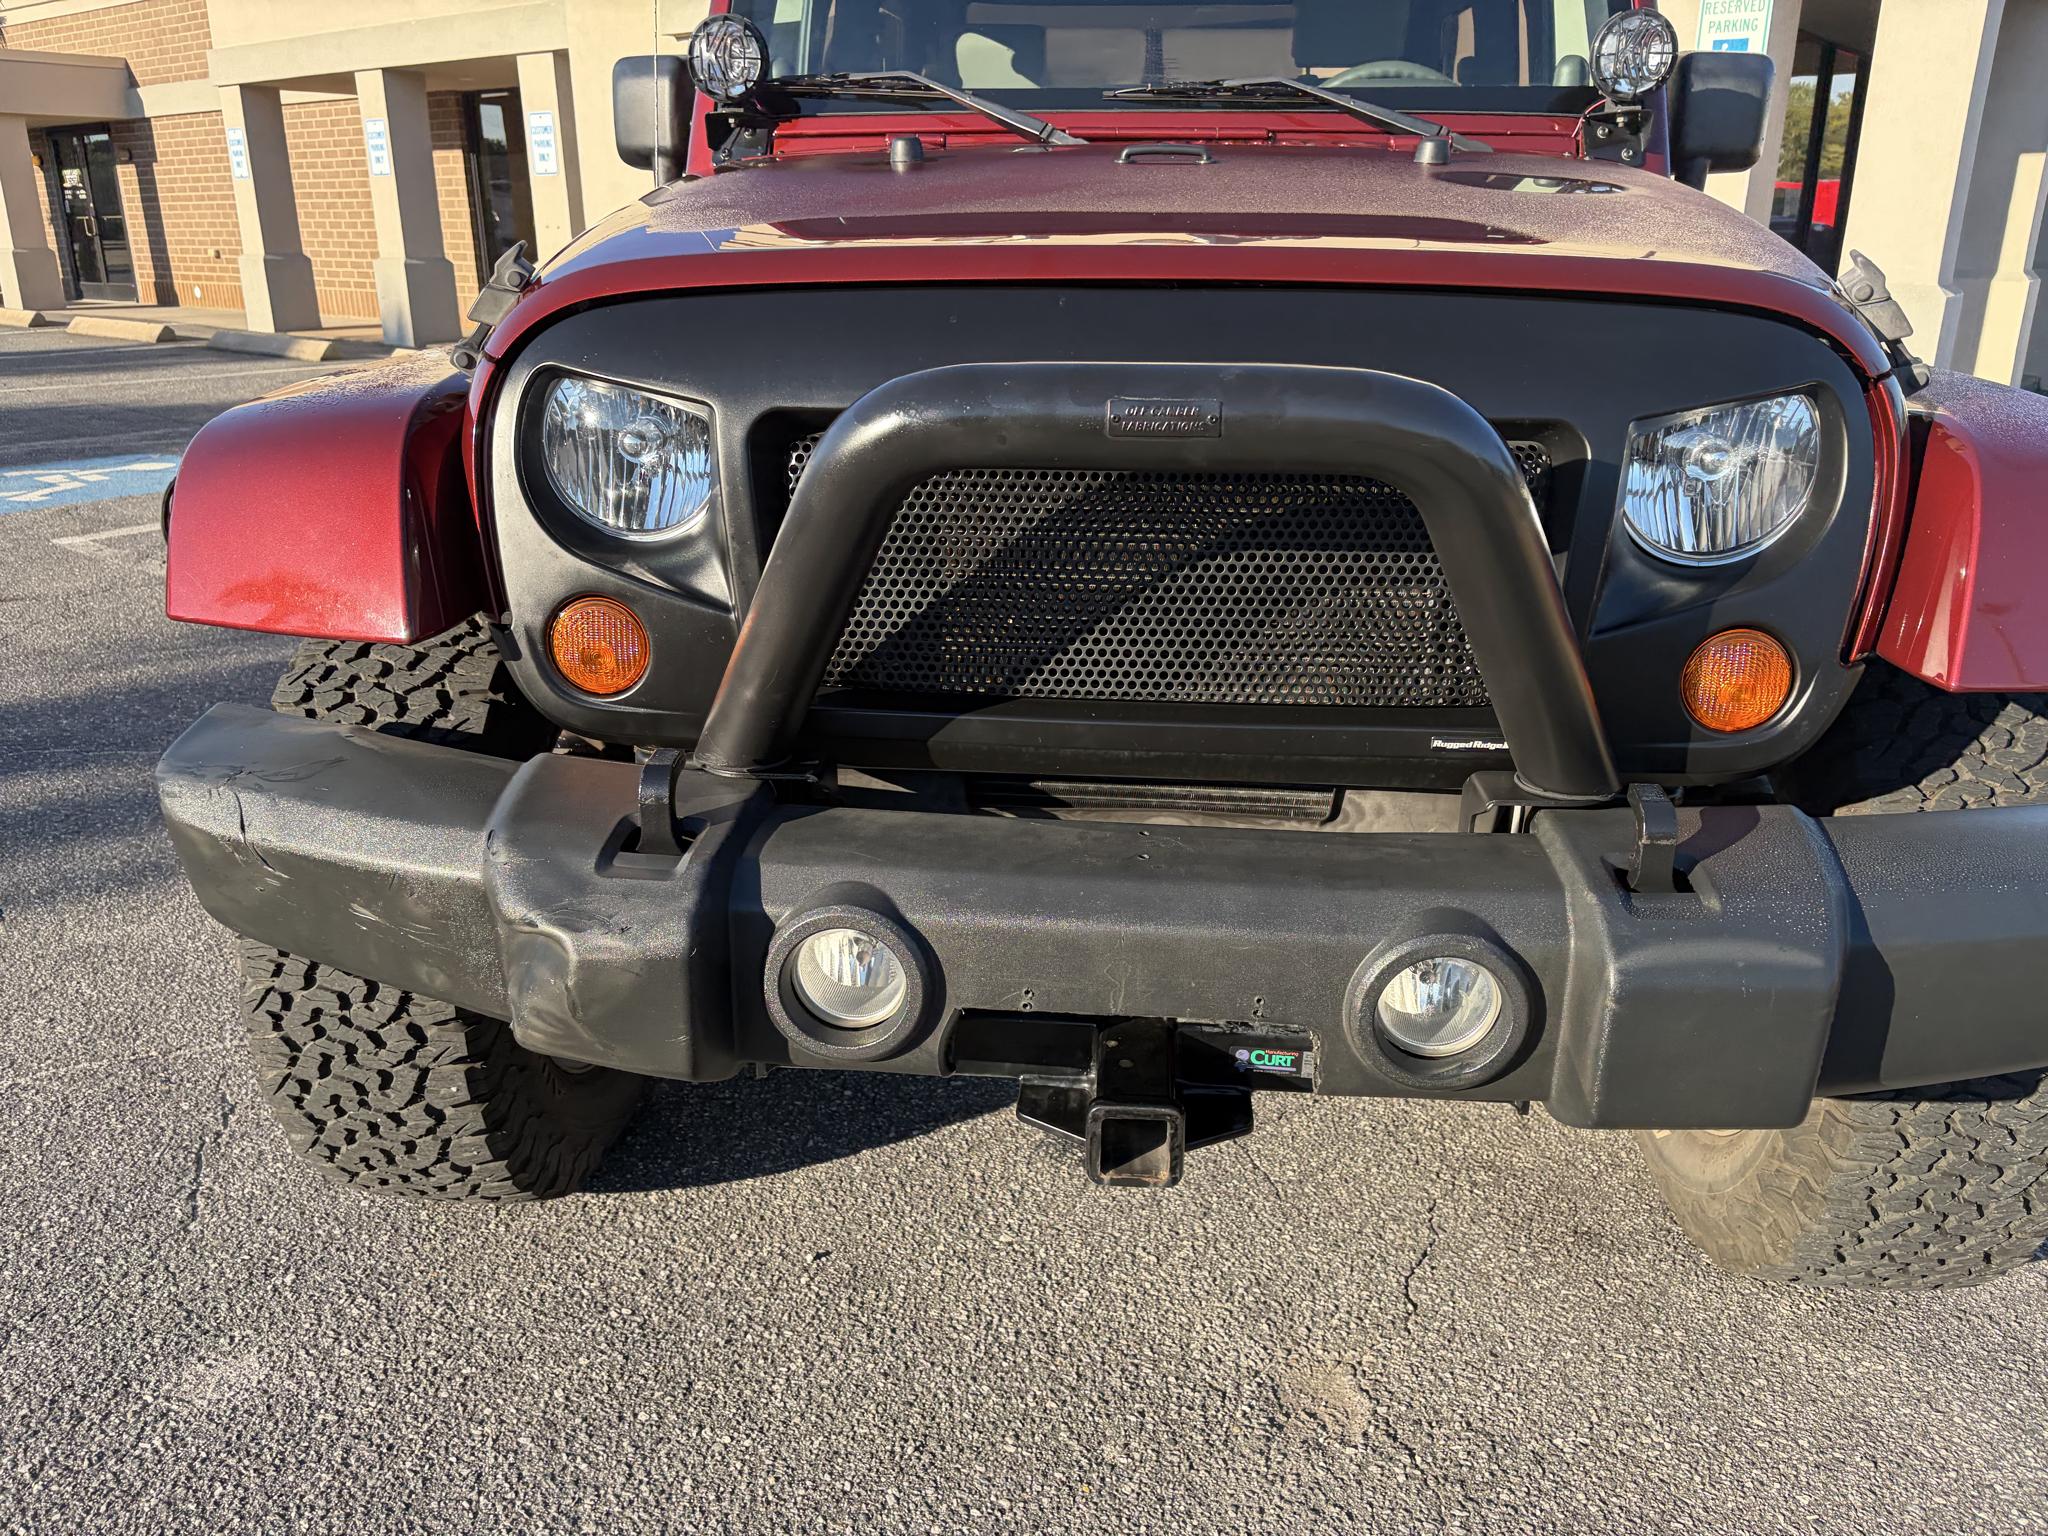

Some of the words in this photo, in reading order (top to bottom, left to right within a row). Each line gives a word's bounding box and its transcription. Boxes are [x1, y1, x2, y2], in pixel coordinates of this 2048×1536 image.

[1705, 0, 1765, 15] RESERVED
[1708, 18, 1759, 34] PARKING
[1432, 739, 1473, 750] Rugged
[1472, 740, 1503, 750] Ridge
